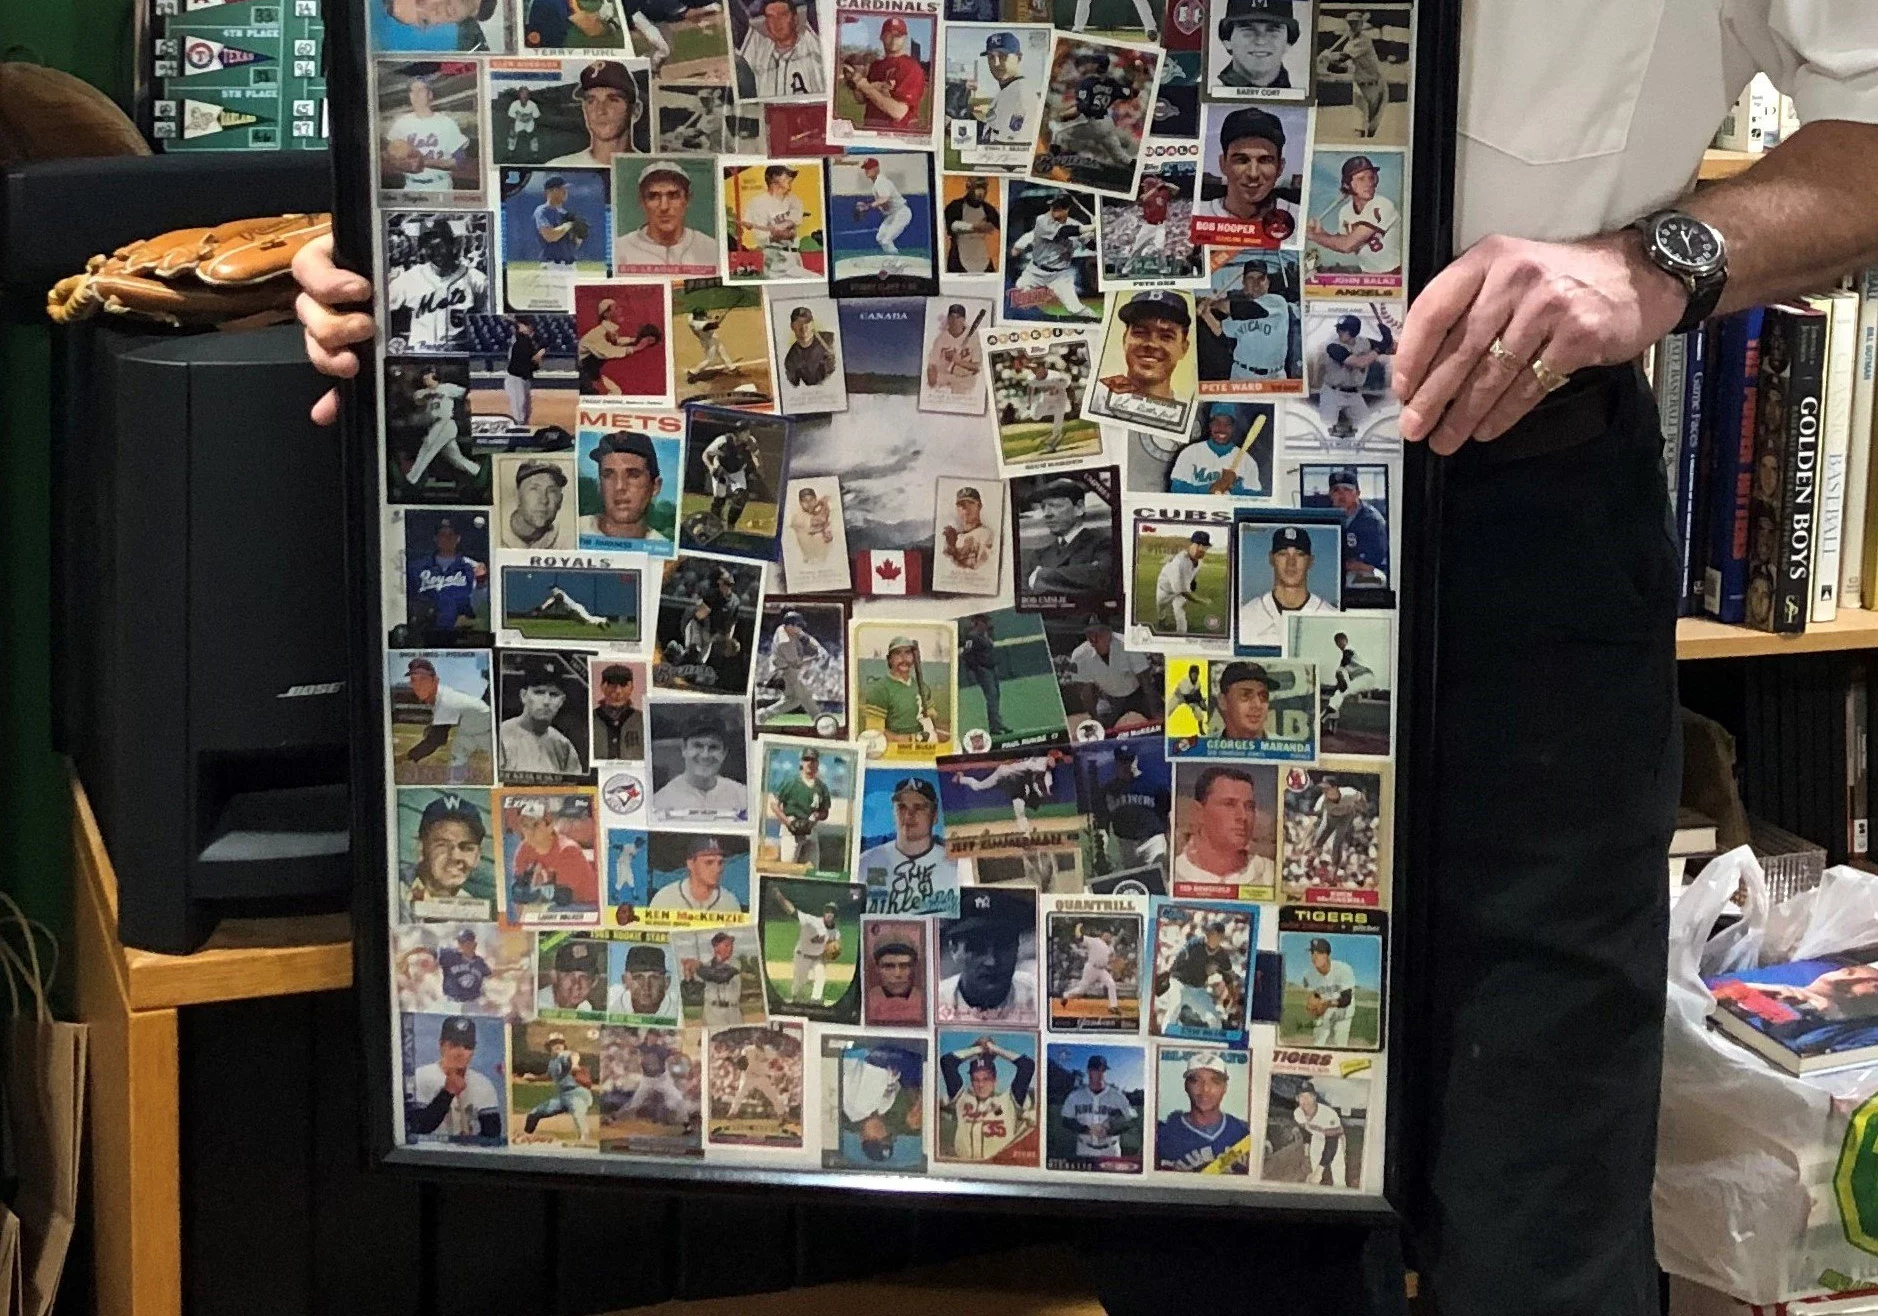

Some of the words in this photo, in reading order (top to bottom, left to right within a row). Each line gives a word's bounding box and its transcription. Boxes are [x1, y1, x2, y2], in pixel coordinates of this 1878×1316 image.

[246, 29, 279, 38] PLACE
[533, 48, 574, 57] TERRY
[244, 90, 278, 99] PLACE
[1195, 220, 1216, 231] BOB
[1217, 222, 1256, 234] HOOPER
[1335, 288, 1393, 297] ANGELS
[859, 312, 908, 321] CANADA
[1201, 383, 1227, 392] PETE
[1232, 382, 1263, 391] WARD
[1692, 371, 1703, 411] Game
[1668, 368, 1682, 428] BASEBALL
[579, 410, 682, 433] METS
[1689, 413, 1702, 448] Faces
[1793, 396, 1819, 504] GOLDEN
[1822, 453, 1844, 555] BASEBALL
[1132, 507, 1233, 521] CUBS
[1789, 510, 1812, 581] BOYS
[529, 556, 613, 568] ROYALS
[1206, 740, 1256, 751] GEORGES
[1260, 741, 1311, 753] MARANDA
[1055, 899, 1136, 912] QUANTRILL
[645, 911, 670, 920] KEN
[676, 912, 744, 923] MacKENZIE
[1294, 909, 1368, 924] TIGERS
[1272, 1050, 1334, 1066] TIGERS
